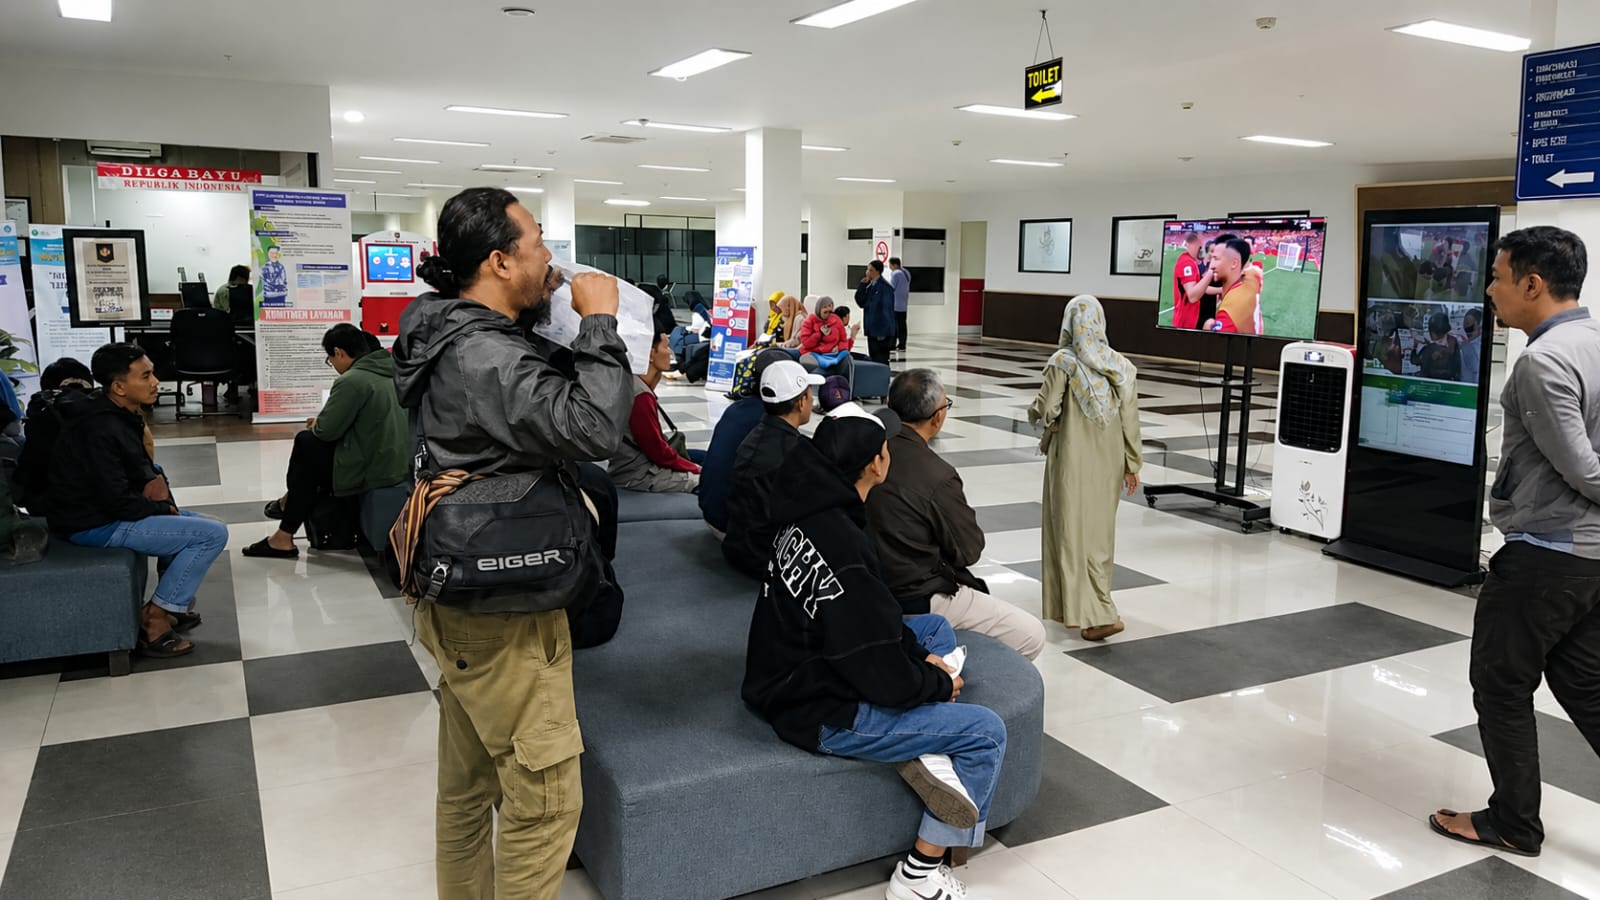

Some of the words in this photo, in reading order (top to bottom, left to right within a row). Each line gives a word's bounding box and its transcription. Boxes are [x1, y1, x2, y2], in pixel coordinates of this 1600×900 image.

[1027, 65, 1060, 89] TOILET
[1531, 153, 1555, 164] TOILET
[121, 166, 182, 178] DILGA
[187, 169, 241, 181] BAYU
[123, 180, 180, 190] REPUBLIK
[184, 181, 242, 191] INDONESIA
[477, 549, 566, 571] EIGER
[773, 523, 845, 620] CHY
